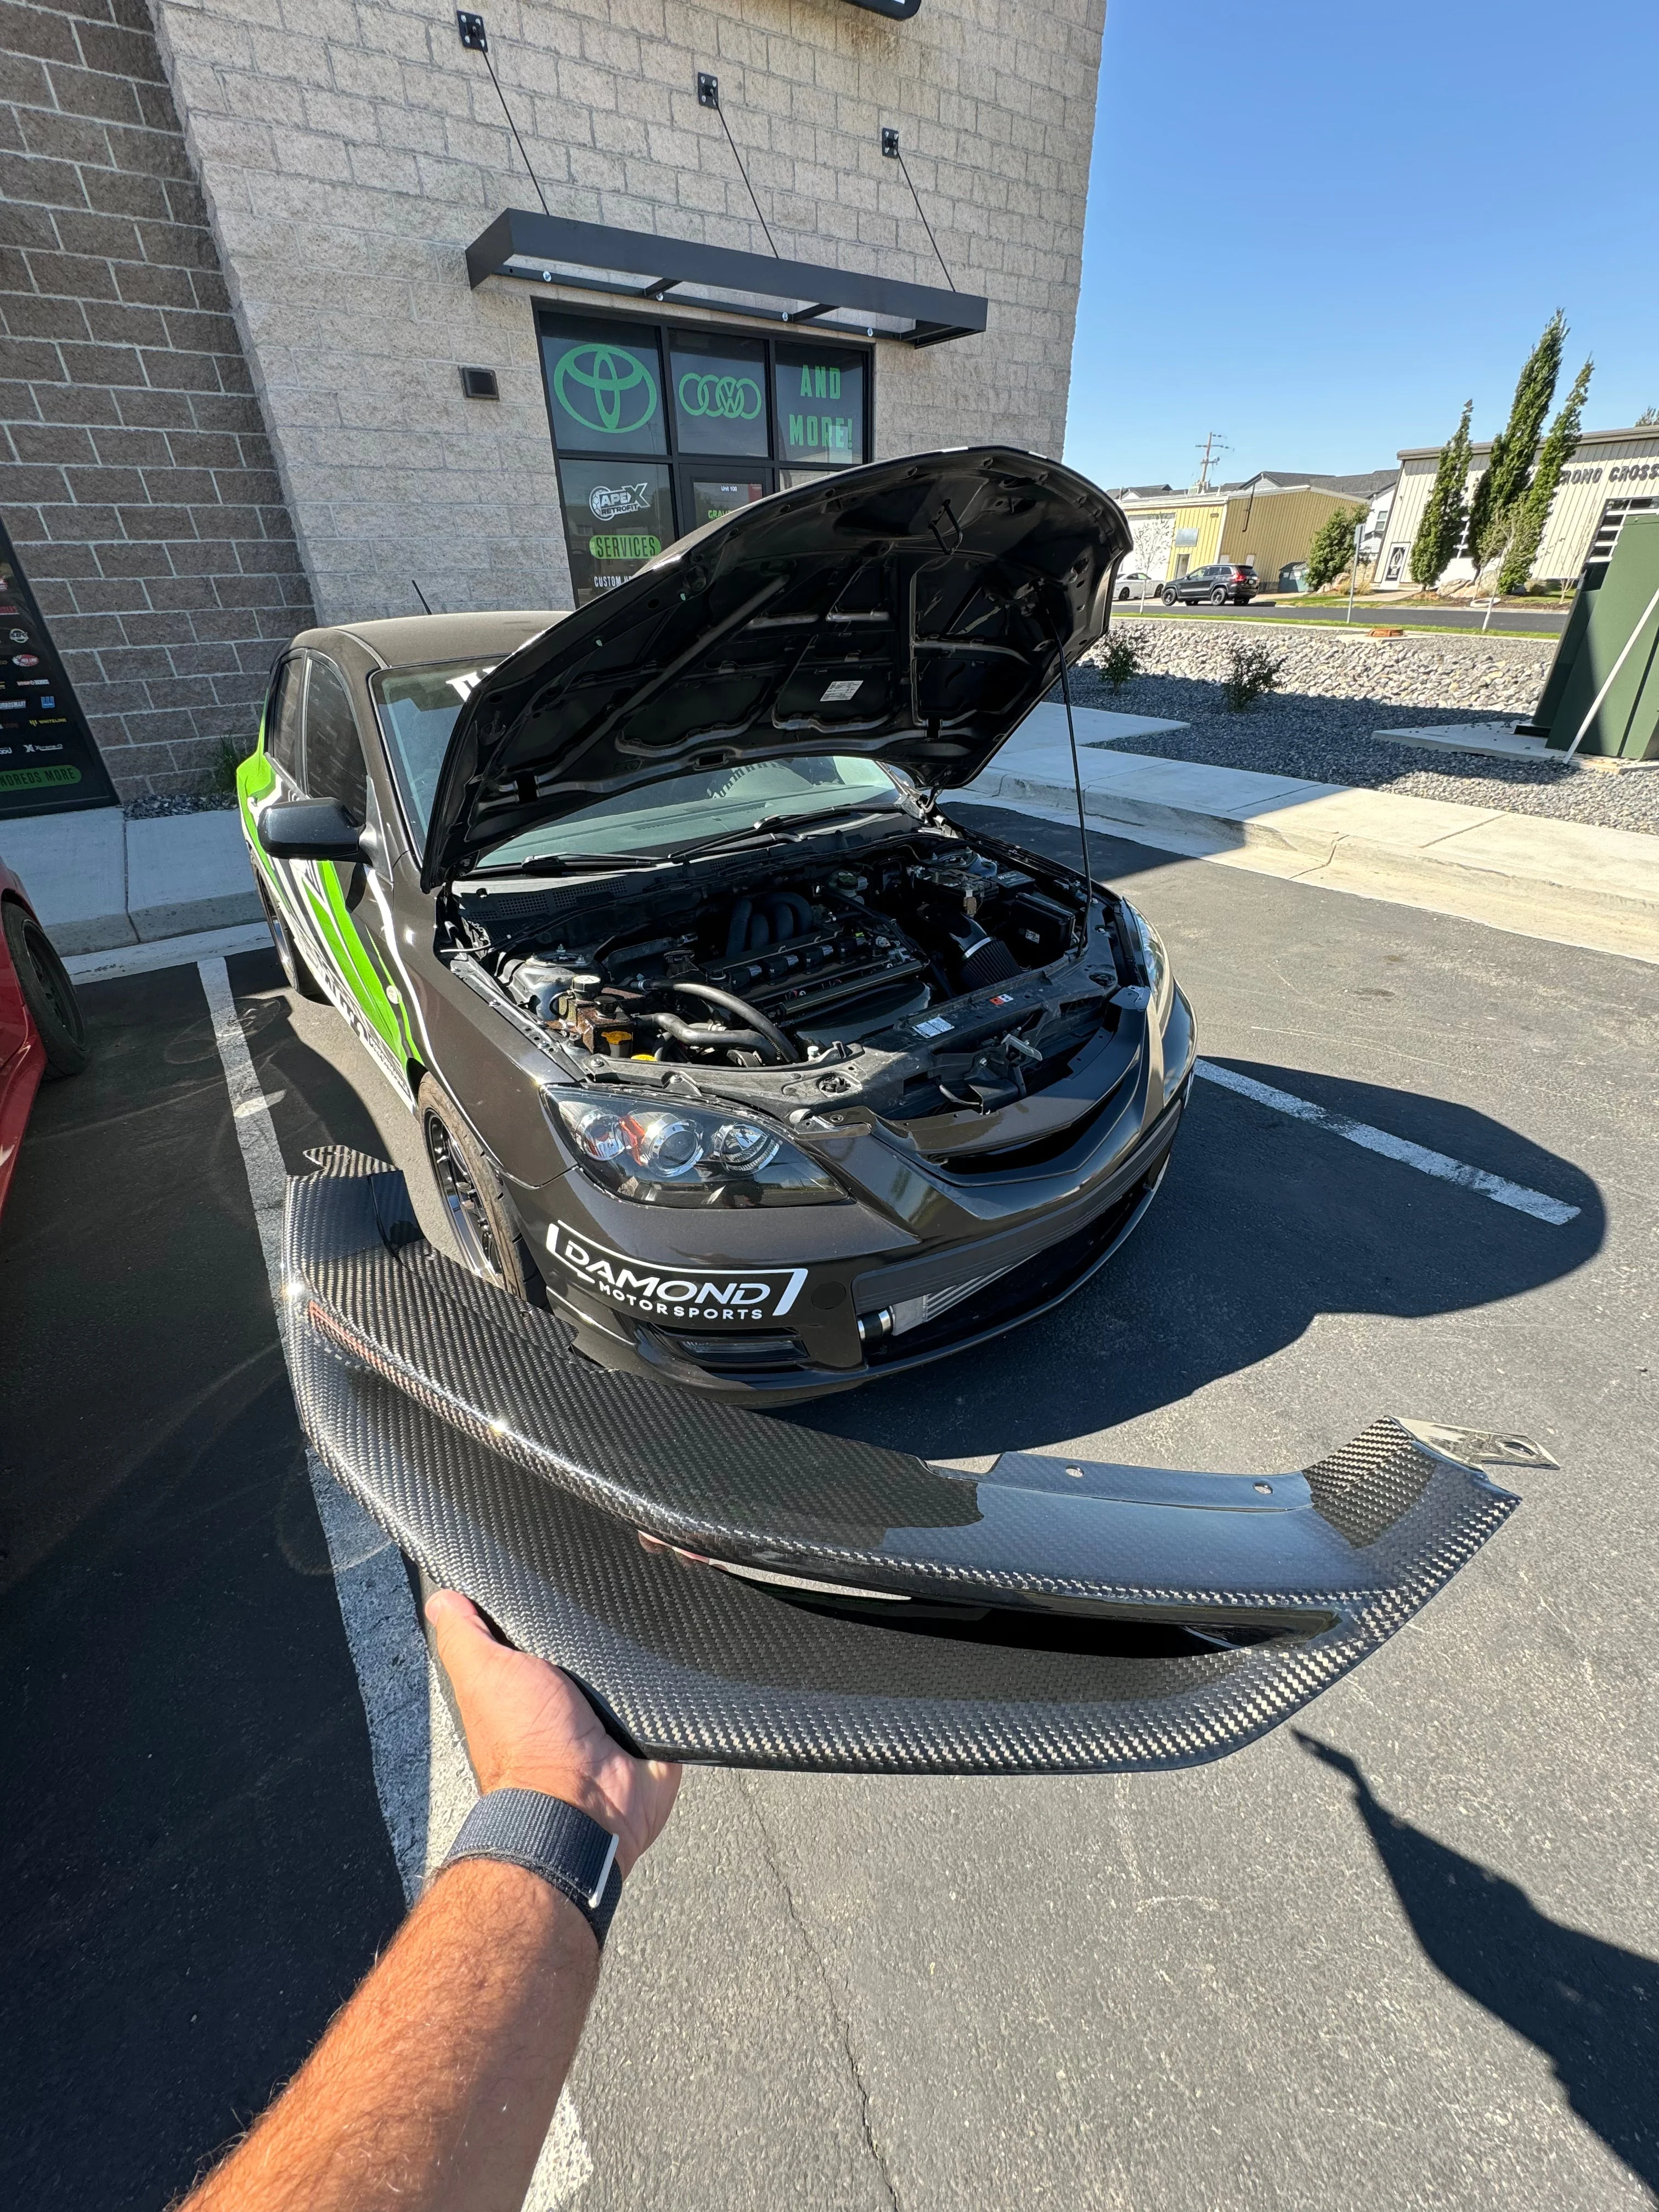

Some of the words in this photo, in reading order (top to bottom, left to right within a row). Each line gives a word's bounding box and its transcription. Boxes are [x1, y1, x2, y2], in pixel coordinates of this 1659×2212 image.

[800, 364, 841, 400] AND
[789, 414, 853, 449] MORE!
[601, 482, 651, 508] APEX
[601, 503, 639, 516] RETROFIT
[596, 536, 656, 558] SERVICES
[594, 575, 622, 588] CUSTOM
[44, 768, 76, 782] MORE
[564, 1240, 771, 1305] DAMOND
[599, 1280, 763, 1320] MOTORSPORTS
